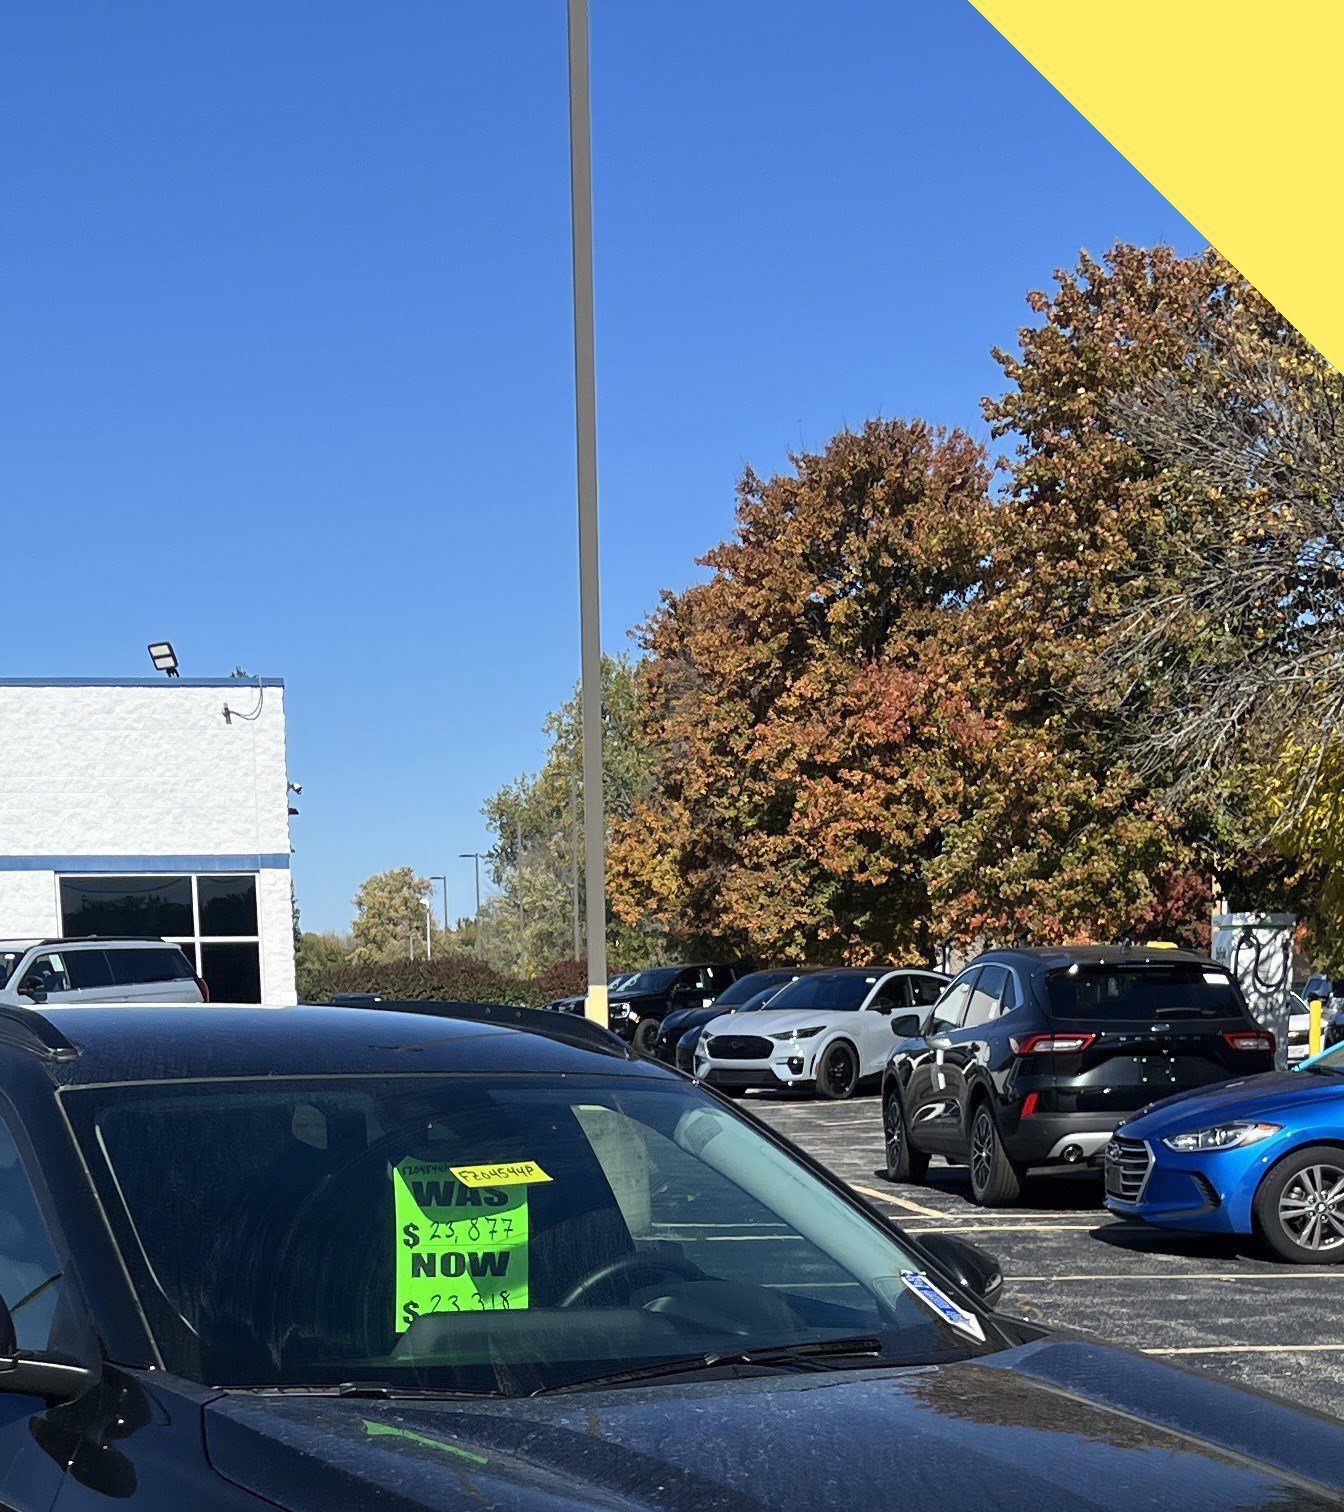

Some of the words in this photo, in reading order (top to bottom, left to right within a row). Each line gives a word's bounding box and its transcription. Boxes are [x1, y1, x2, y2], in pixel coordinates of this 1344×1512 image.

[411, 1181, 509, 1207] WAS
[402, 1222, 420, 1249] $
[411, 1251, 511, 1279] NOW
[402, 1300, 420, 1325] $
